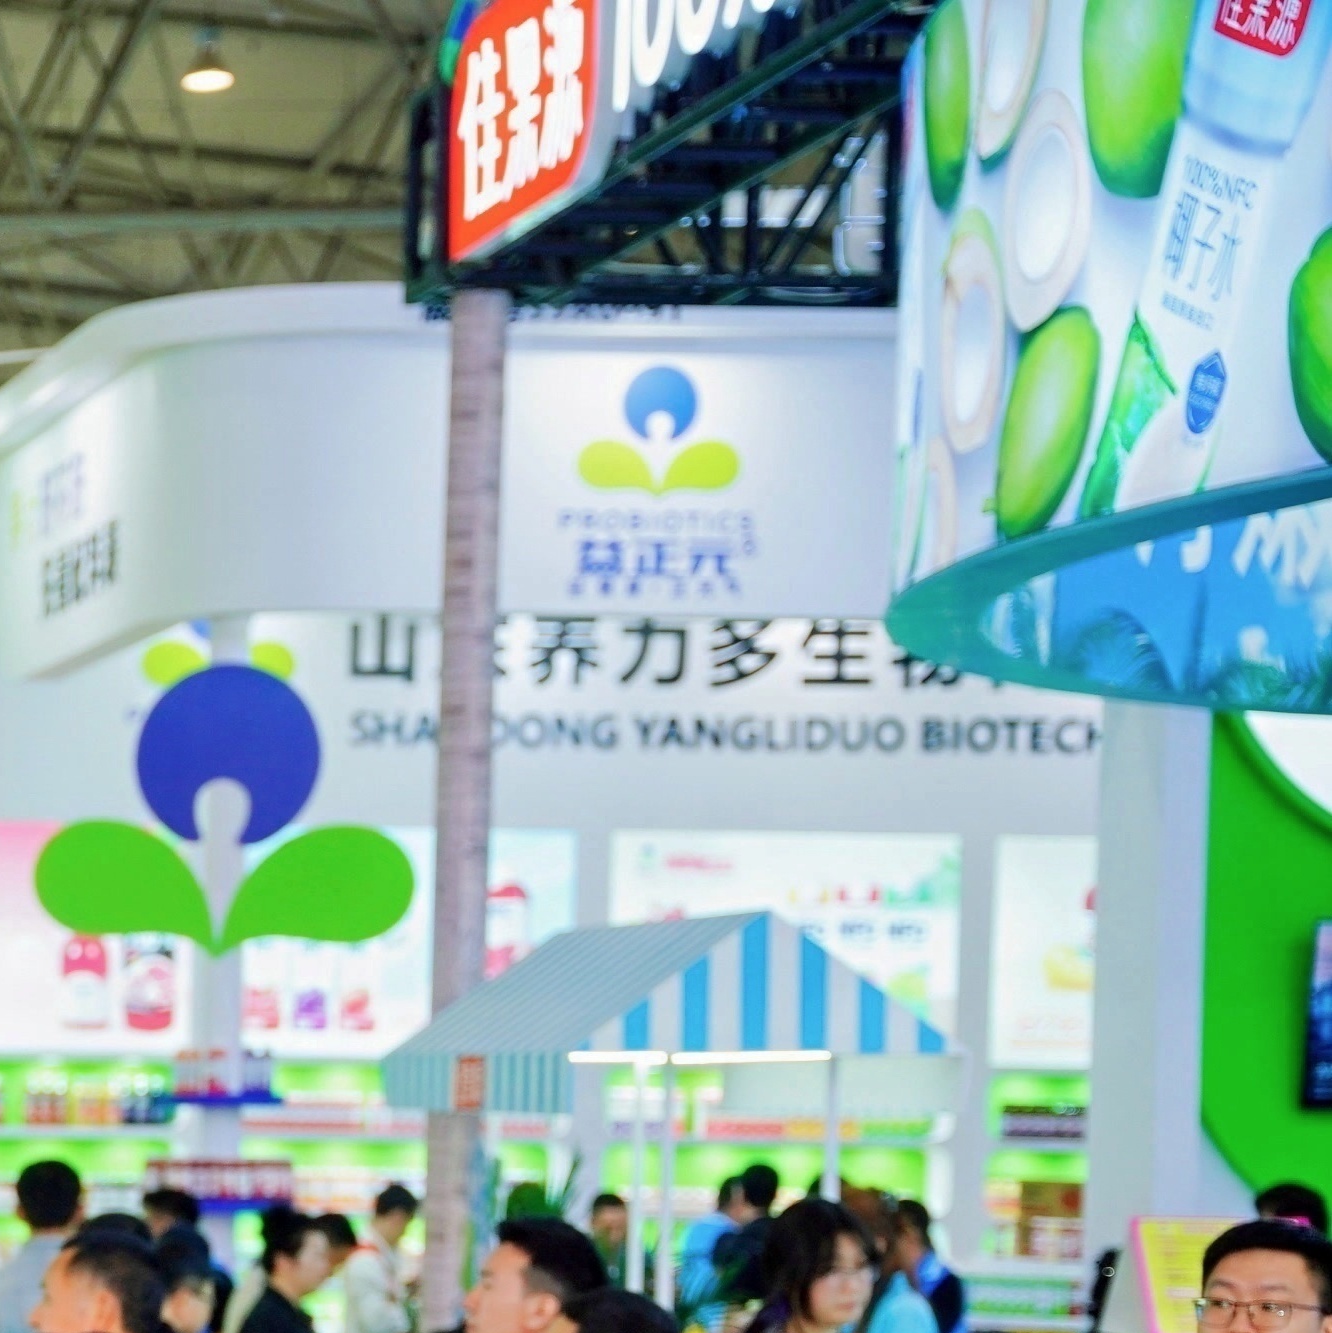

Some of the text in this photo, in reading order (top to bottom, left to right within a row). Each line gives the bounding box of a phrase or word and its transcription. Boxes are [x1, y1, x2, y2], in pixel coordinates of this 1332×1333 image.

[457, 2, 584, 220] 佳果源
[557, 507, 756, 533] PROBIOTICS
[350, 612, 963, 688] 山养力多生
[351, 712, 618, 750] SHADONG
[635, 713, 905, 755] YANGLIDUO
